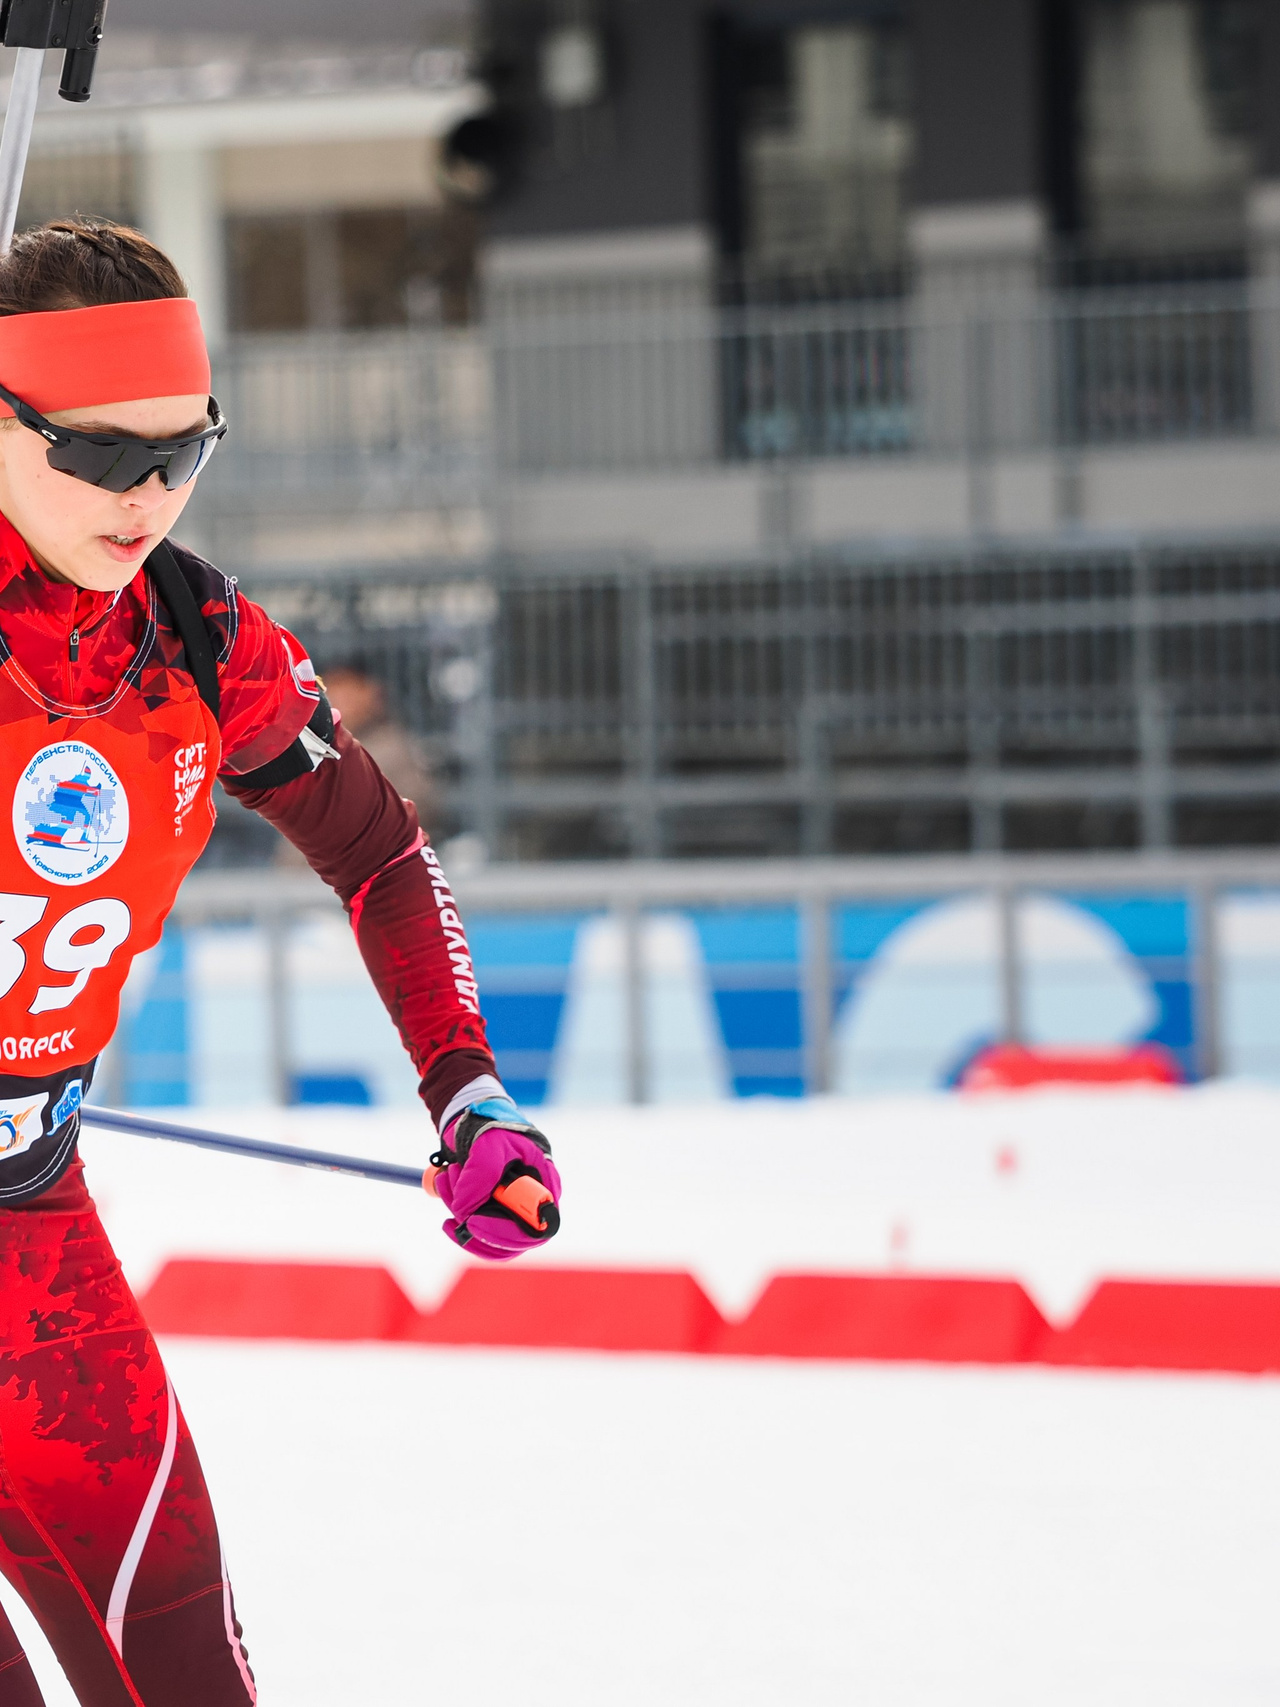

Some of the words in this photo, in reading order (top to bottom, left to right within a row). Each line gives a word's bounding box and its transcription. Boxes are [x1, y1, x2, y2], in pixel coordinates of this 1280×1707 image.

[24, 744, 83, 781] ПЕРВЕНСТВО
[85, 749, 118, 787] РОССИИ
[32, 854, 83, 880] Красноярск
[86, 854, 109, 875] 2023
